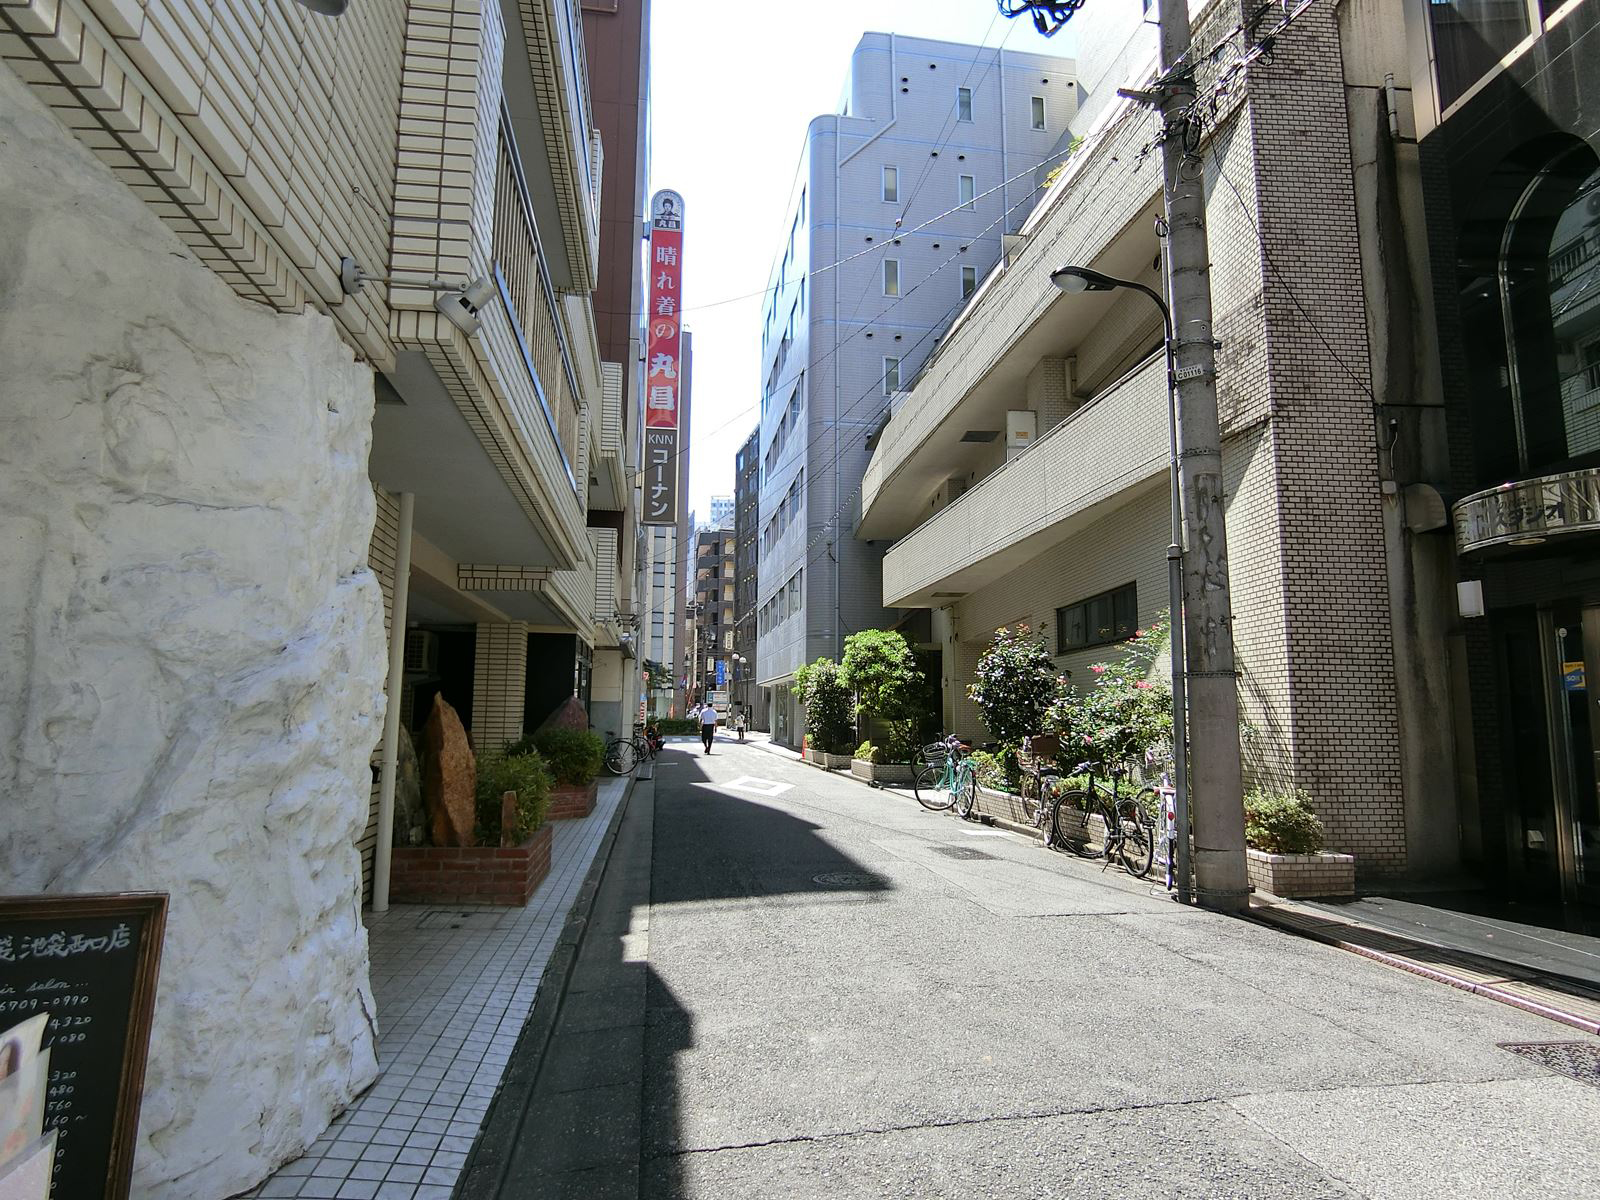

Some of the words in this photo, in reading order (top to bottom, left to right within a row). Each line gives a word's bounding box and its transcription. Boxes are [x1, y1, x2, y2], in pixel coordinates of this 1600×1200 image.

[648, 434, 674, 445] KNN
[650, 448, 669, 517] コーナン
[50, 1015, 92, 1029] 4320
[48, 1032, 87, 1047] 1080
